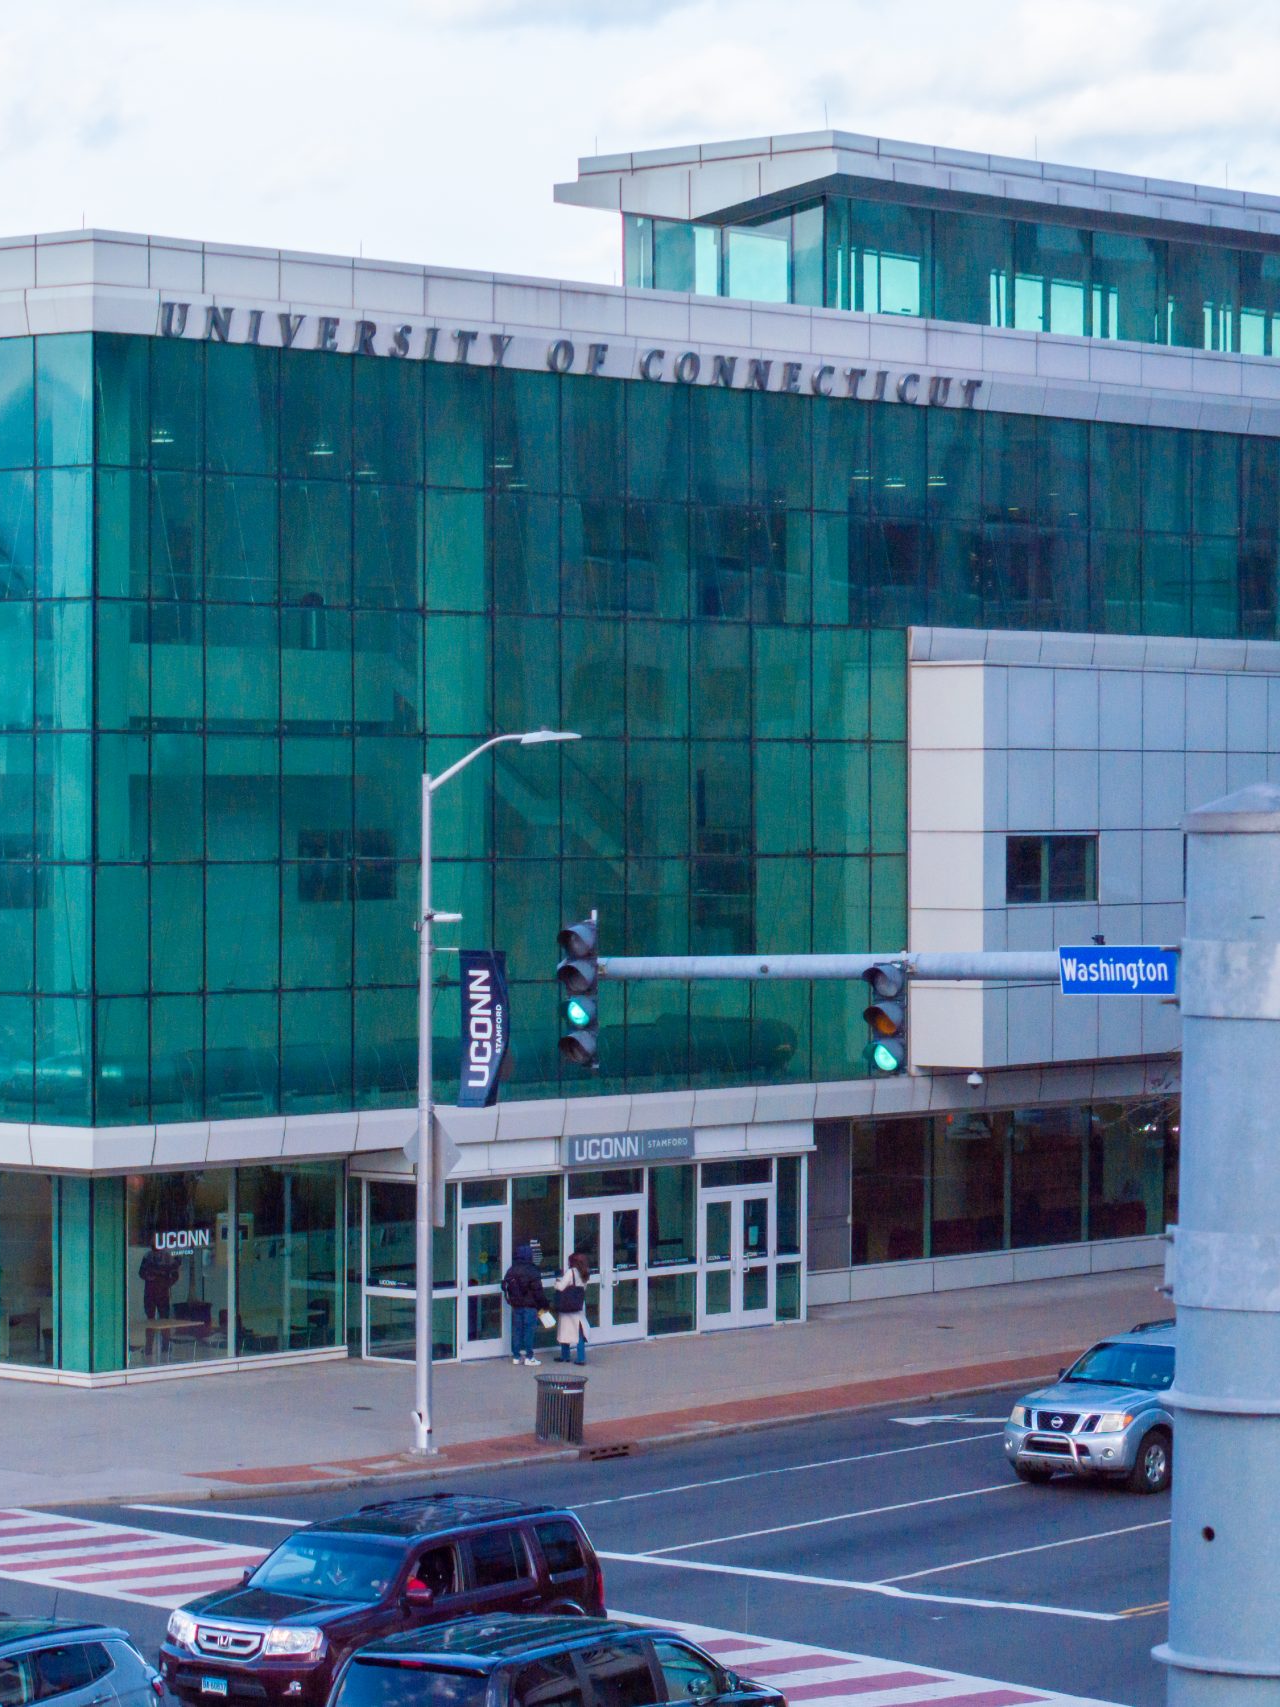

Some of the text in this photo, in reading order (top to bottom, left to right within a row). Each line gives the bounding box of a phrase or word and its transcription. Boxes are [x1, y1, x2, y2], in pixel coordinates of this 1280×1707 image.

[160, 302, 982, 408] UNIVERSITY OF CONNECTICUT
[1061, 957, 1169, 990] Washington
[468, 969, 493, 1088] UCONN
[495, 1004, 503, 1054] STAMFORD
[575, 1136, 688, 1161] UCONN STAMFORD
[155, 1229, 210, 1250] UCONN
